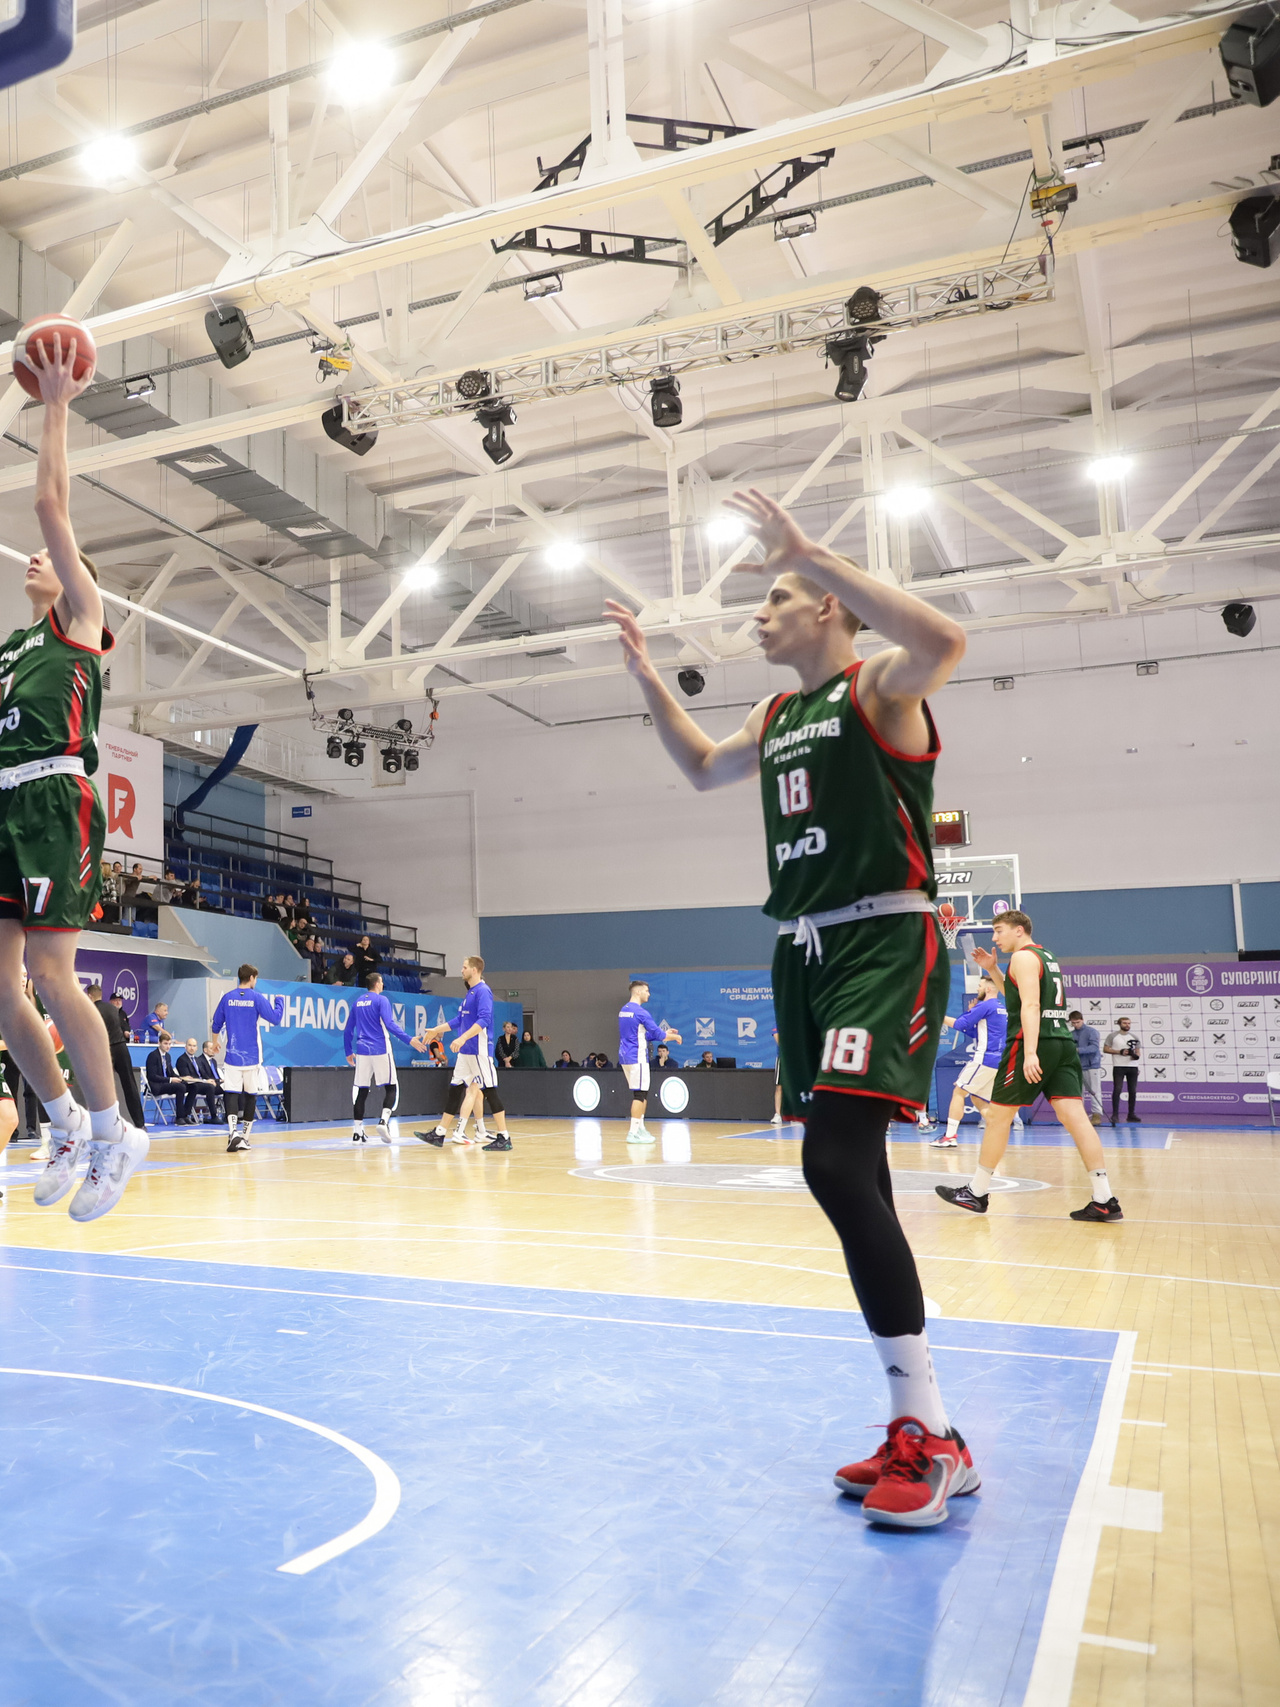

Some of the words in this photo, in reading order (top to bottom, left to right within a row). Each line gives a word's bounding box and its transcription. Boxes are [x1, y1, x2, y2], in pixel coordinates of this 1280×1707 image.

[105, 743, 139, 758] ГЕНЕРАЛЬНЫЙ
[111, 751, 133, 763] ПАРТНЕР
[773, 745, 812, 765] КУБАНЬ
[777, 767, 813, 818] 18
[1074, 973, 1134, 988] ЧЕМПИОНАТ
[1137, 972, 1178, 987] РОССИИ
[117, 986, 136, 1001] РФБ
[821, 1027, 873, 1076] 18
